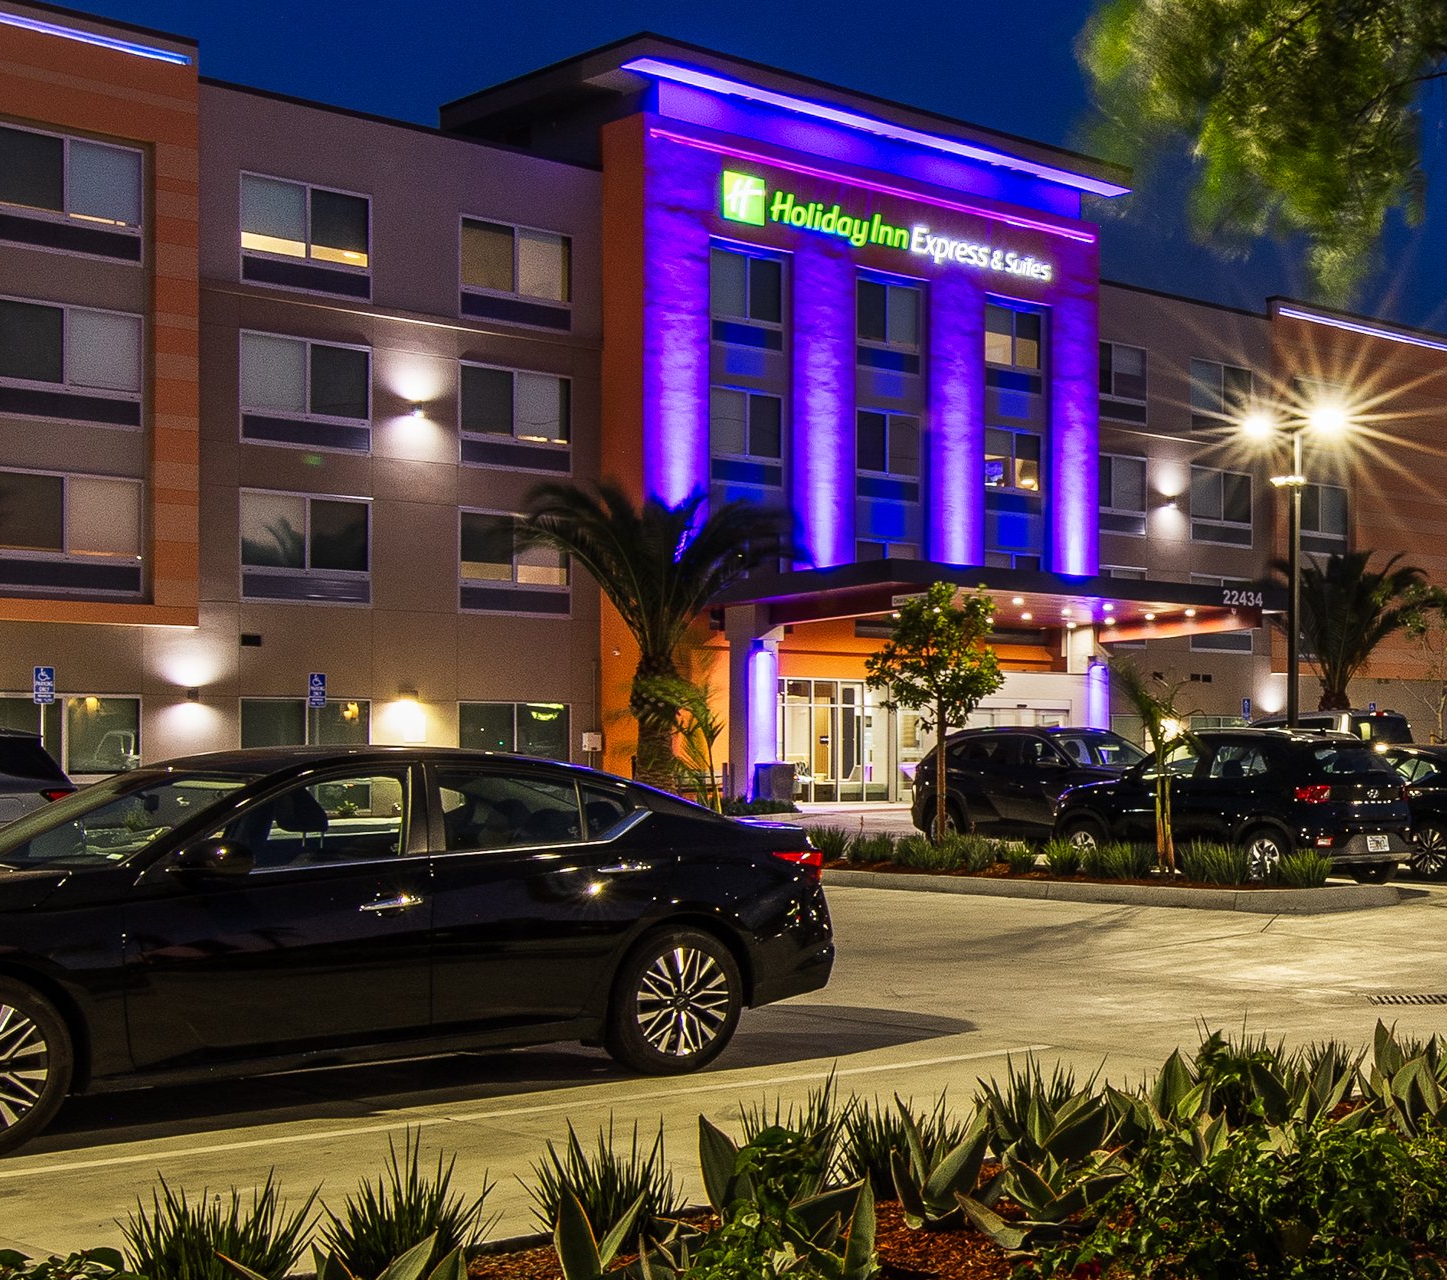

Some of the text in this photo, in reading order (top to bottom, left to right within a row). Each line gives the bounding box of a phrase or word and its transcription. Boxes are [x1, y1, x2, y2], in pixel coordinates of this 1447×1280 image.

[770, 190, 1052, 283] Holiday Inn Express & Suites
[1223, 589, 1263, 607] 22434
